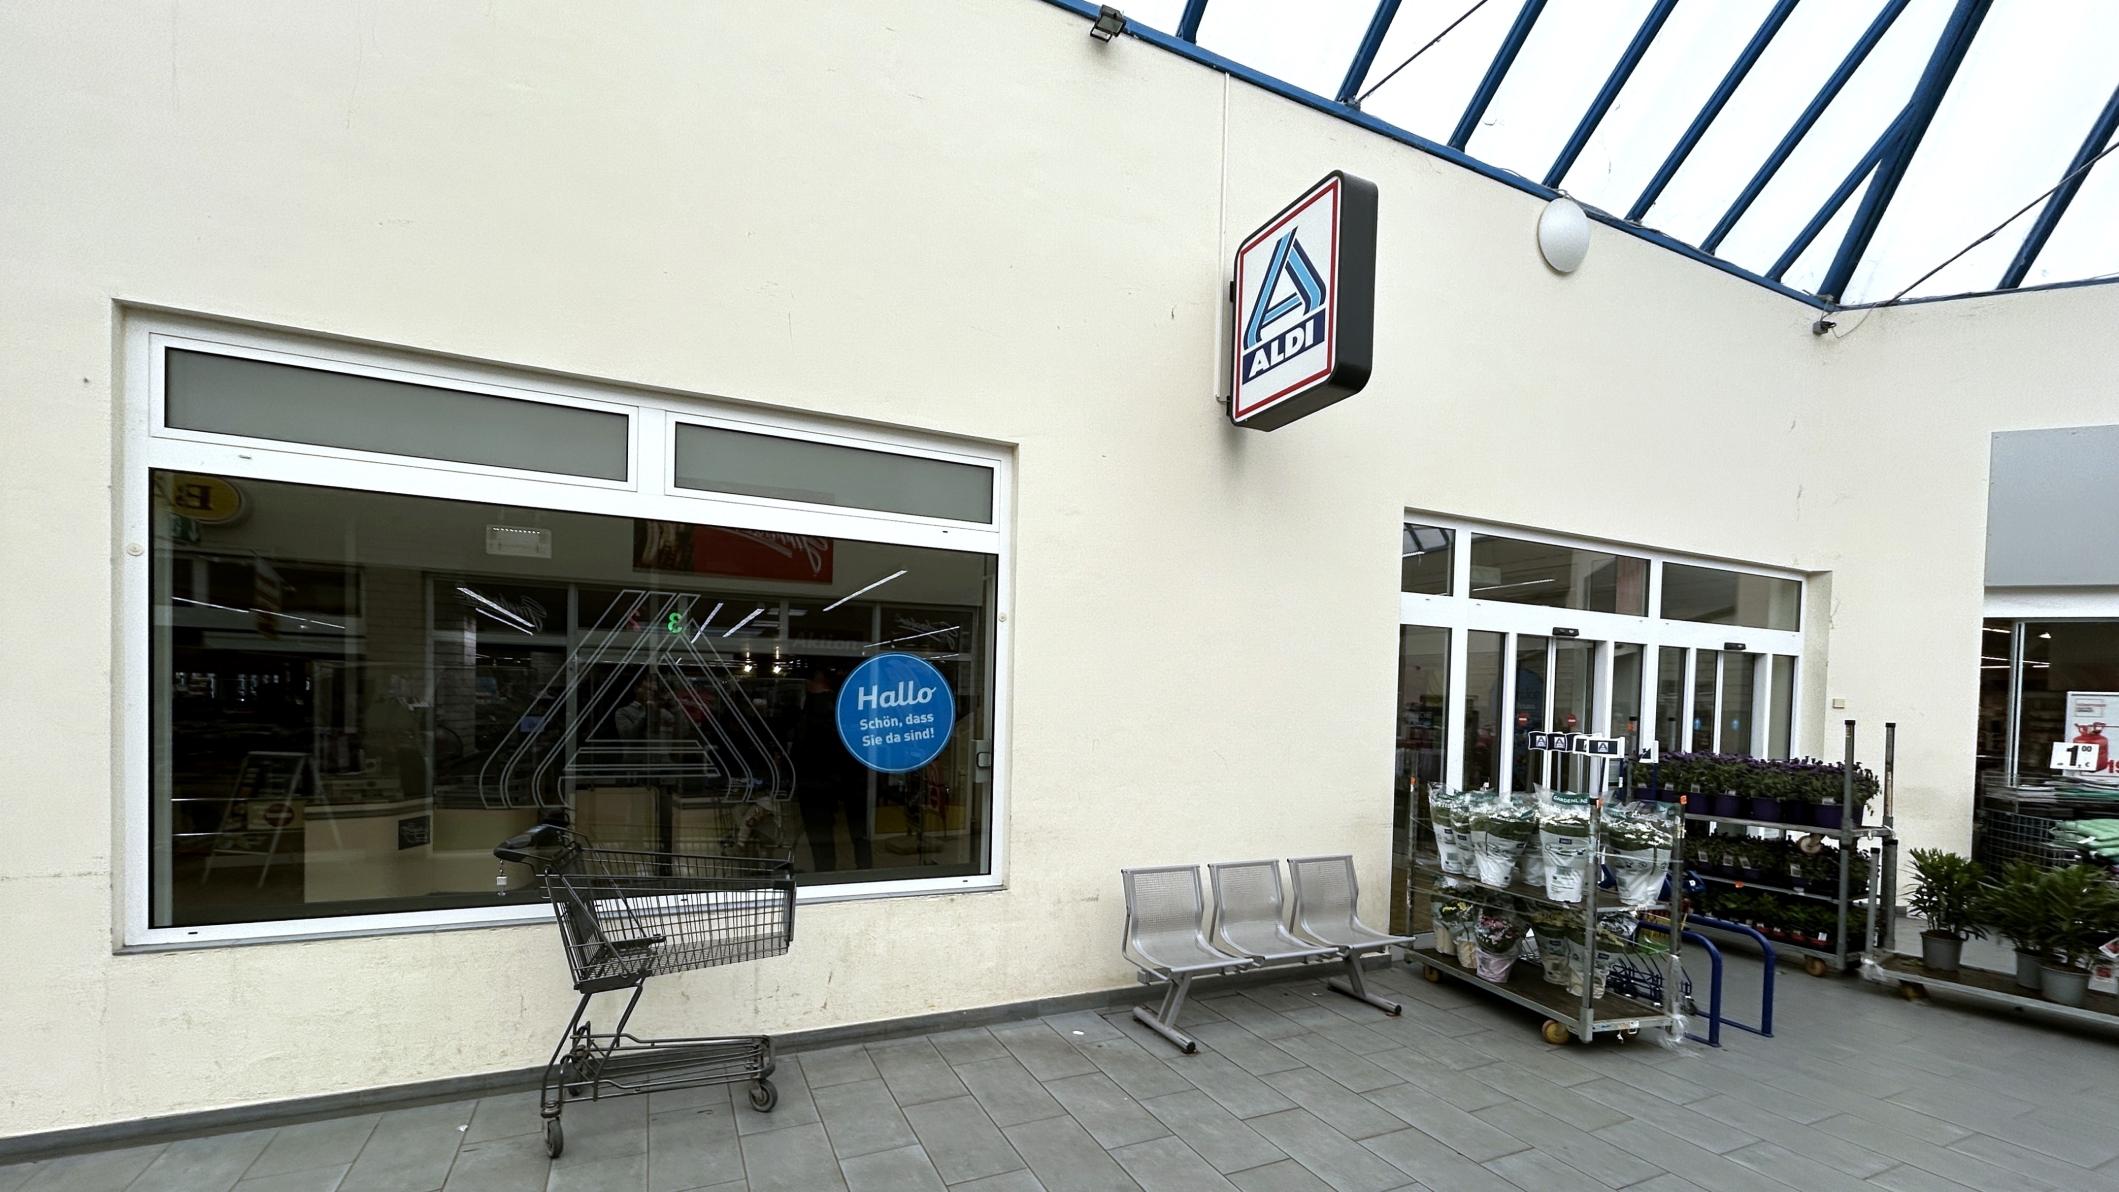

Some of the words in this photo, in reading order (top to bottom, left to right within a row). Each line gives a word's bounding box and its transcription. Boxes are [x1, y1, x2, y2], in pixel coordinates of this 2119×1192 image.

[1248, 318, 1315, 379] ALDI
[857, 680, 937, 710] Hallo
[859, 715, 903, 731] Schön,
[905, 713, 935, 725] dass
[862, 734, 883, 747] Sie
[885, 732, 901, 744] da
[903, 728, 935, 741] sind!
[1553, 795, 1589, 804] GARDENLNE
